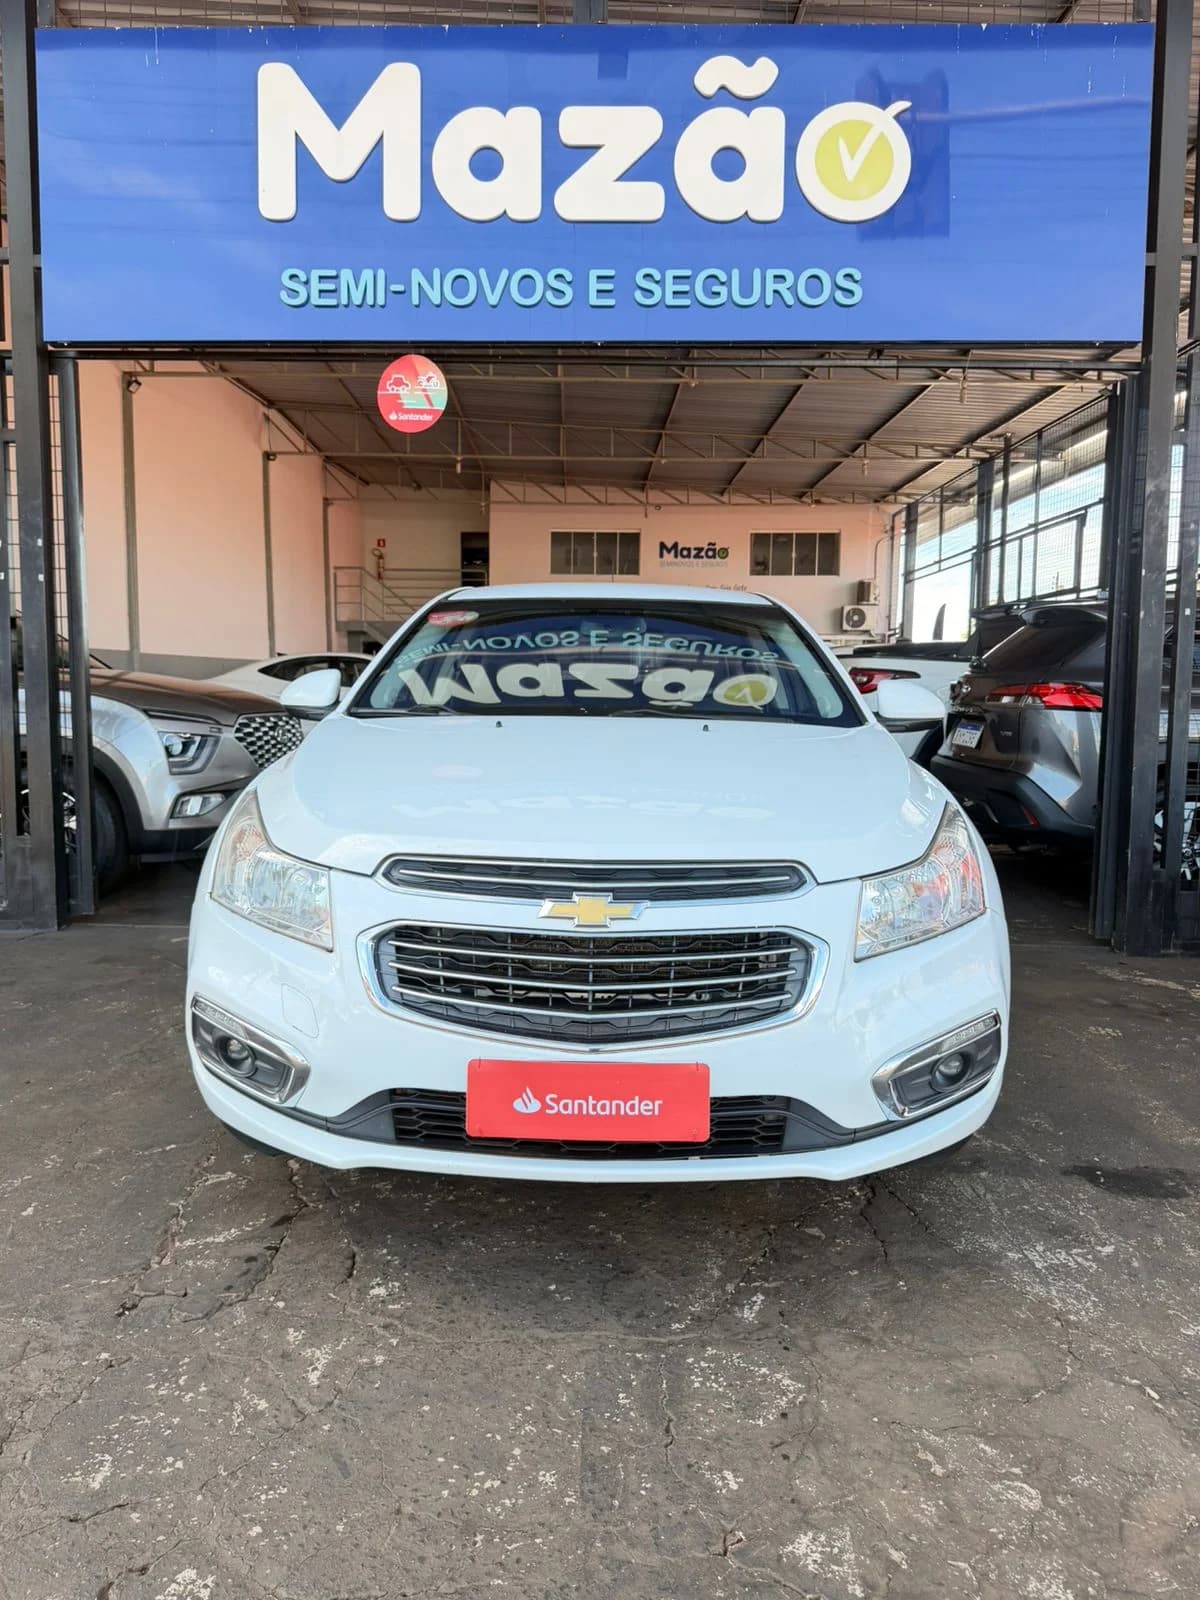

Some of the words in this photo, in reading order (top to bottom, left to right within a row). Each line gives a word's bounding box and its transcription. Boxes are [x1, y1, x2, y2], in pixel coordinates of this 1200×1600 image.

[257, 54, 912, 224] Mazão
[279, 267, 574, 308] SEMI-NOVOS
[588, 268, 617, 307] E
[633, 267, 864, 308] SEGUROS
[658, 541, 730, 560] Mazão
[545, 1093, 663, 1116] Santander
